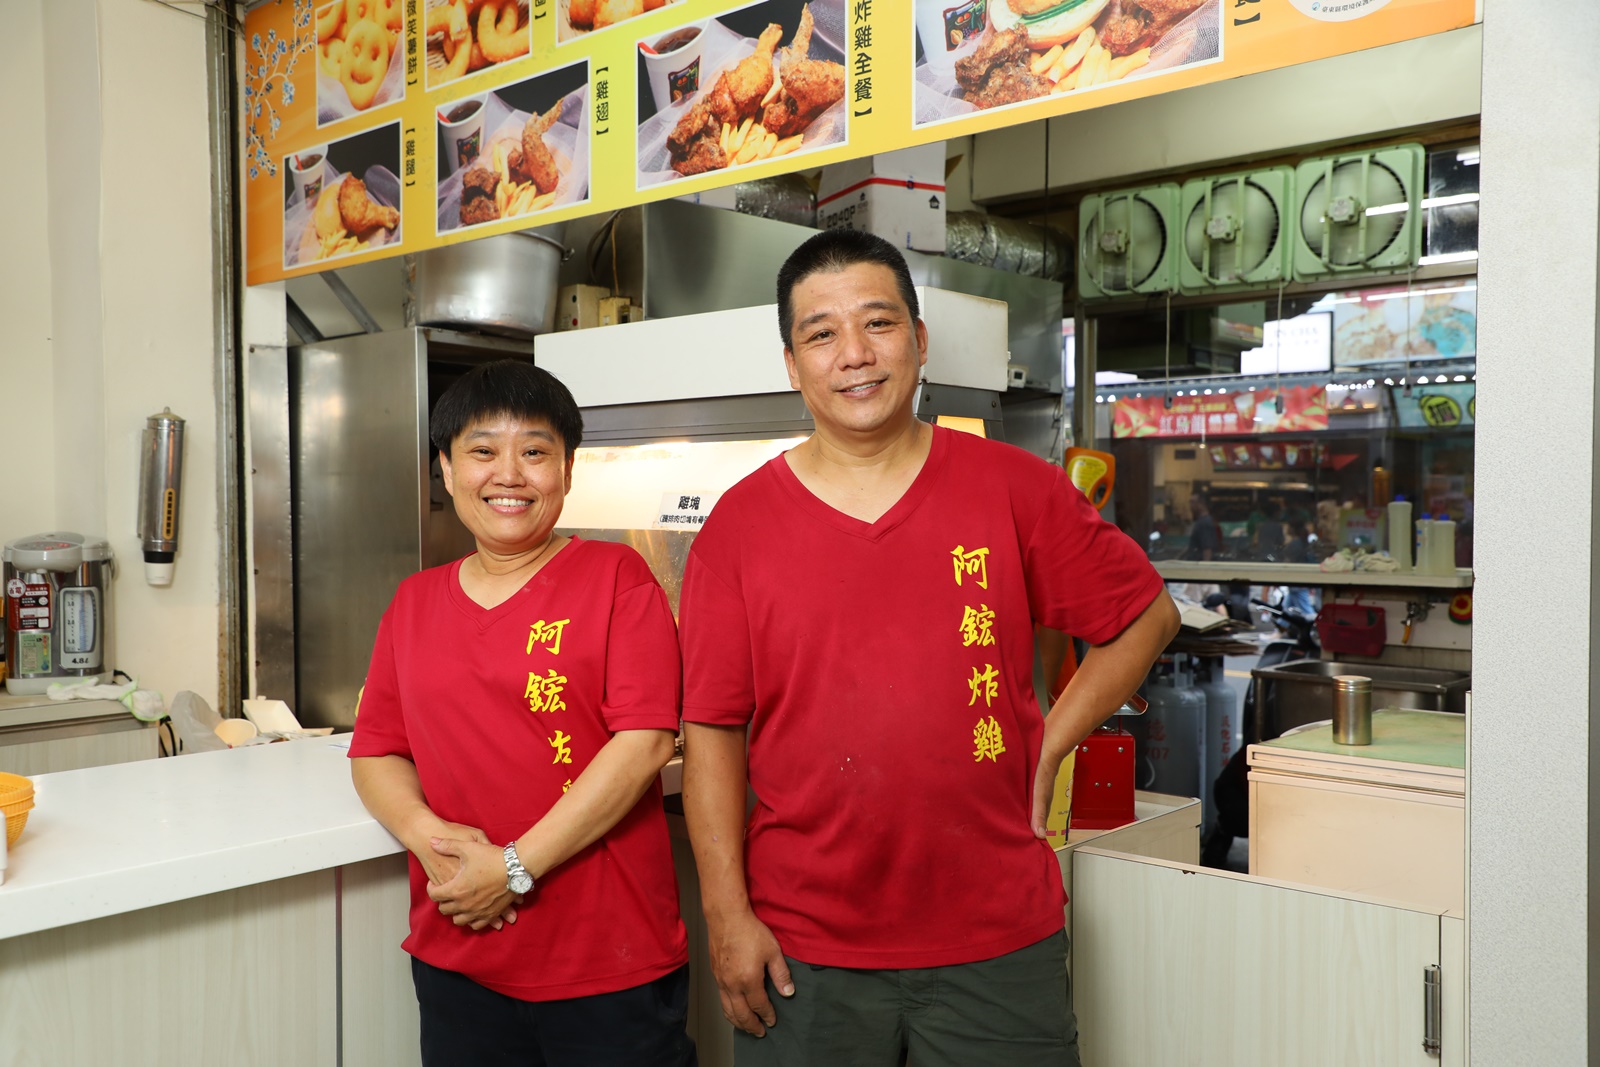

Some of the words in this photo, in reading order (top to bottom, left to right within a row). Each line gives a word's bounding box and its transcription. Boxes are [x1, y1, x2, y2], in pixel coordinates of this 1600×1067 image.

[854, 0, 873, 118] 炸雞全餐】
[949, 544, 1007, 764] 阿鋐炸雞
